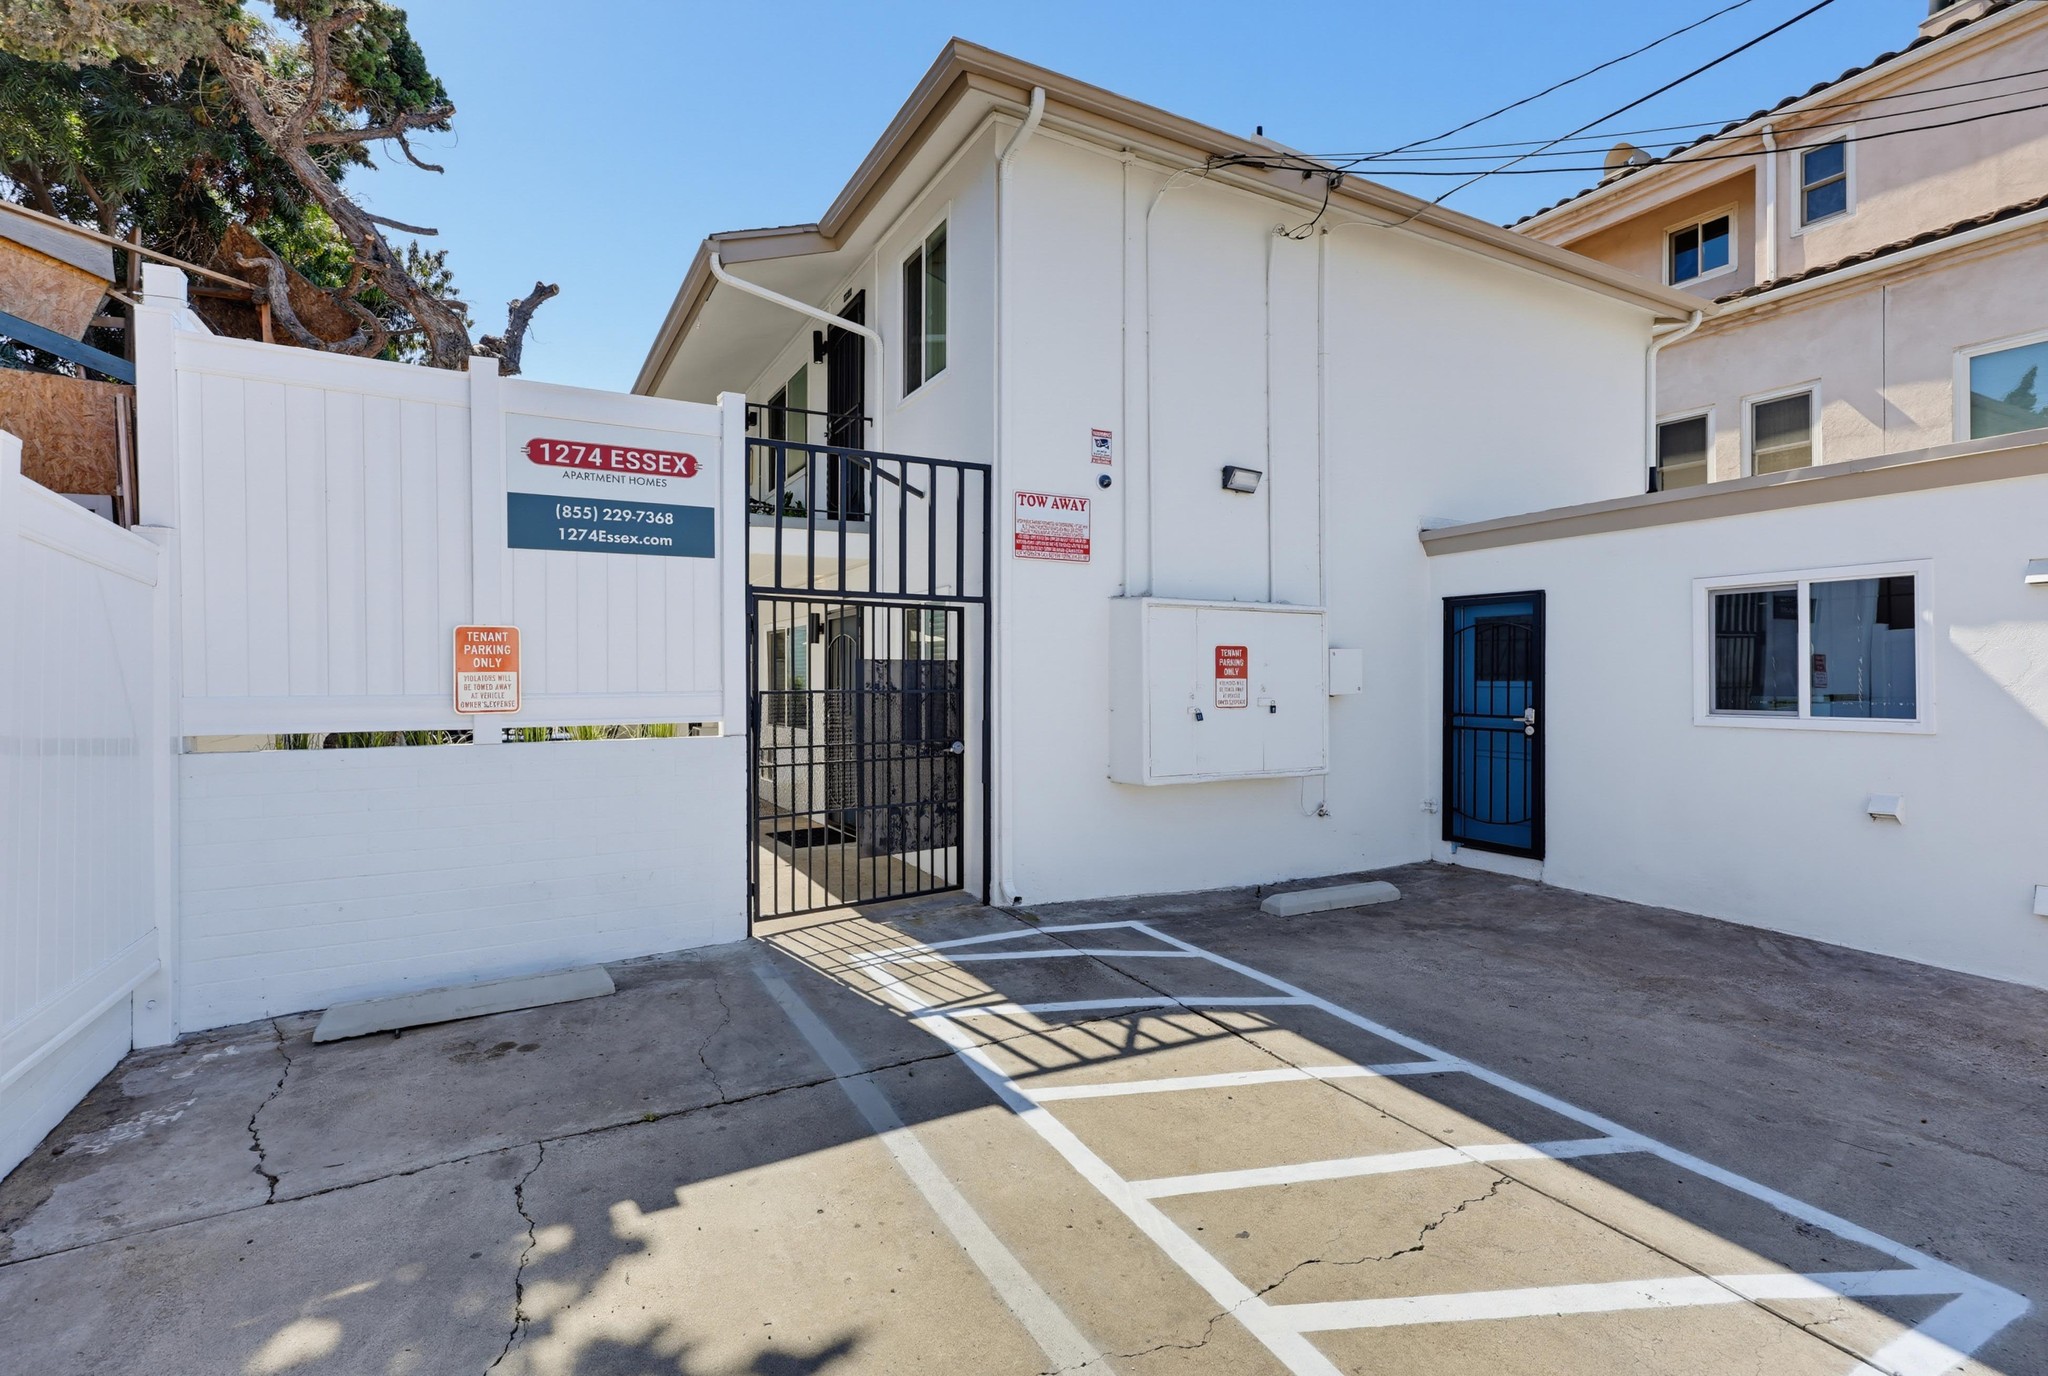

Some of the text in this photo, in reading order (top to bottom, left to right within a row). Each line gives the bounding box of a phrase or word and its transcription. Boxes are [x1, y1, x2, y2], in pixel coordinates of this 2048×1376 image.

[540, 443, 688, 474] 1274 ESSEX
[562, 471, 667, 487] APARTMENT HOMES
[1018, 494, 1087, 511] TOW AWAY
[555, 503, 673, 524] (855) 229-7368
[558, 528, 673, 546] 1274Essex.com
[467, 632, 508, 641] TENANT
[464, 645, 511, 654] PARKING
[1220, 649, 1242, 657] TENANT
[473, 658, 502, 668] ONLY
[1219, 658, 1244, 666] PARKING
[1223, 668, 1239, 676] ONLY
